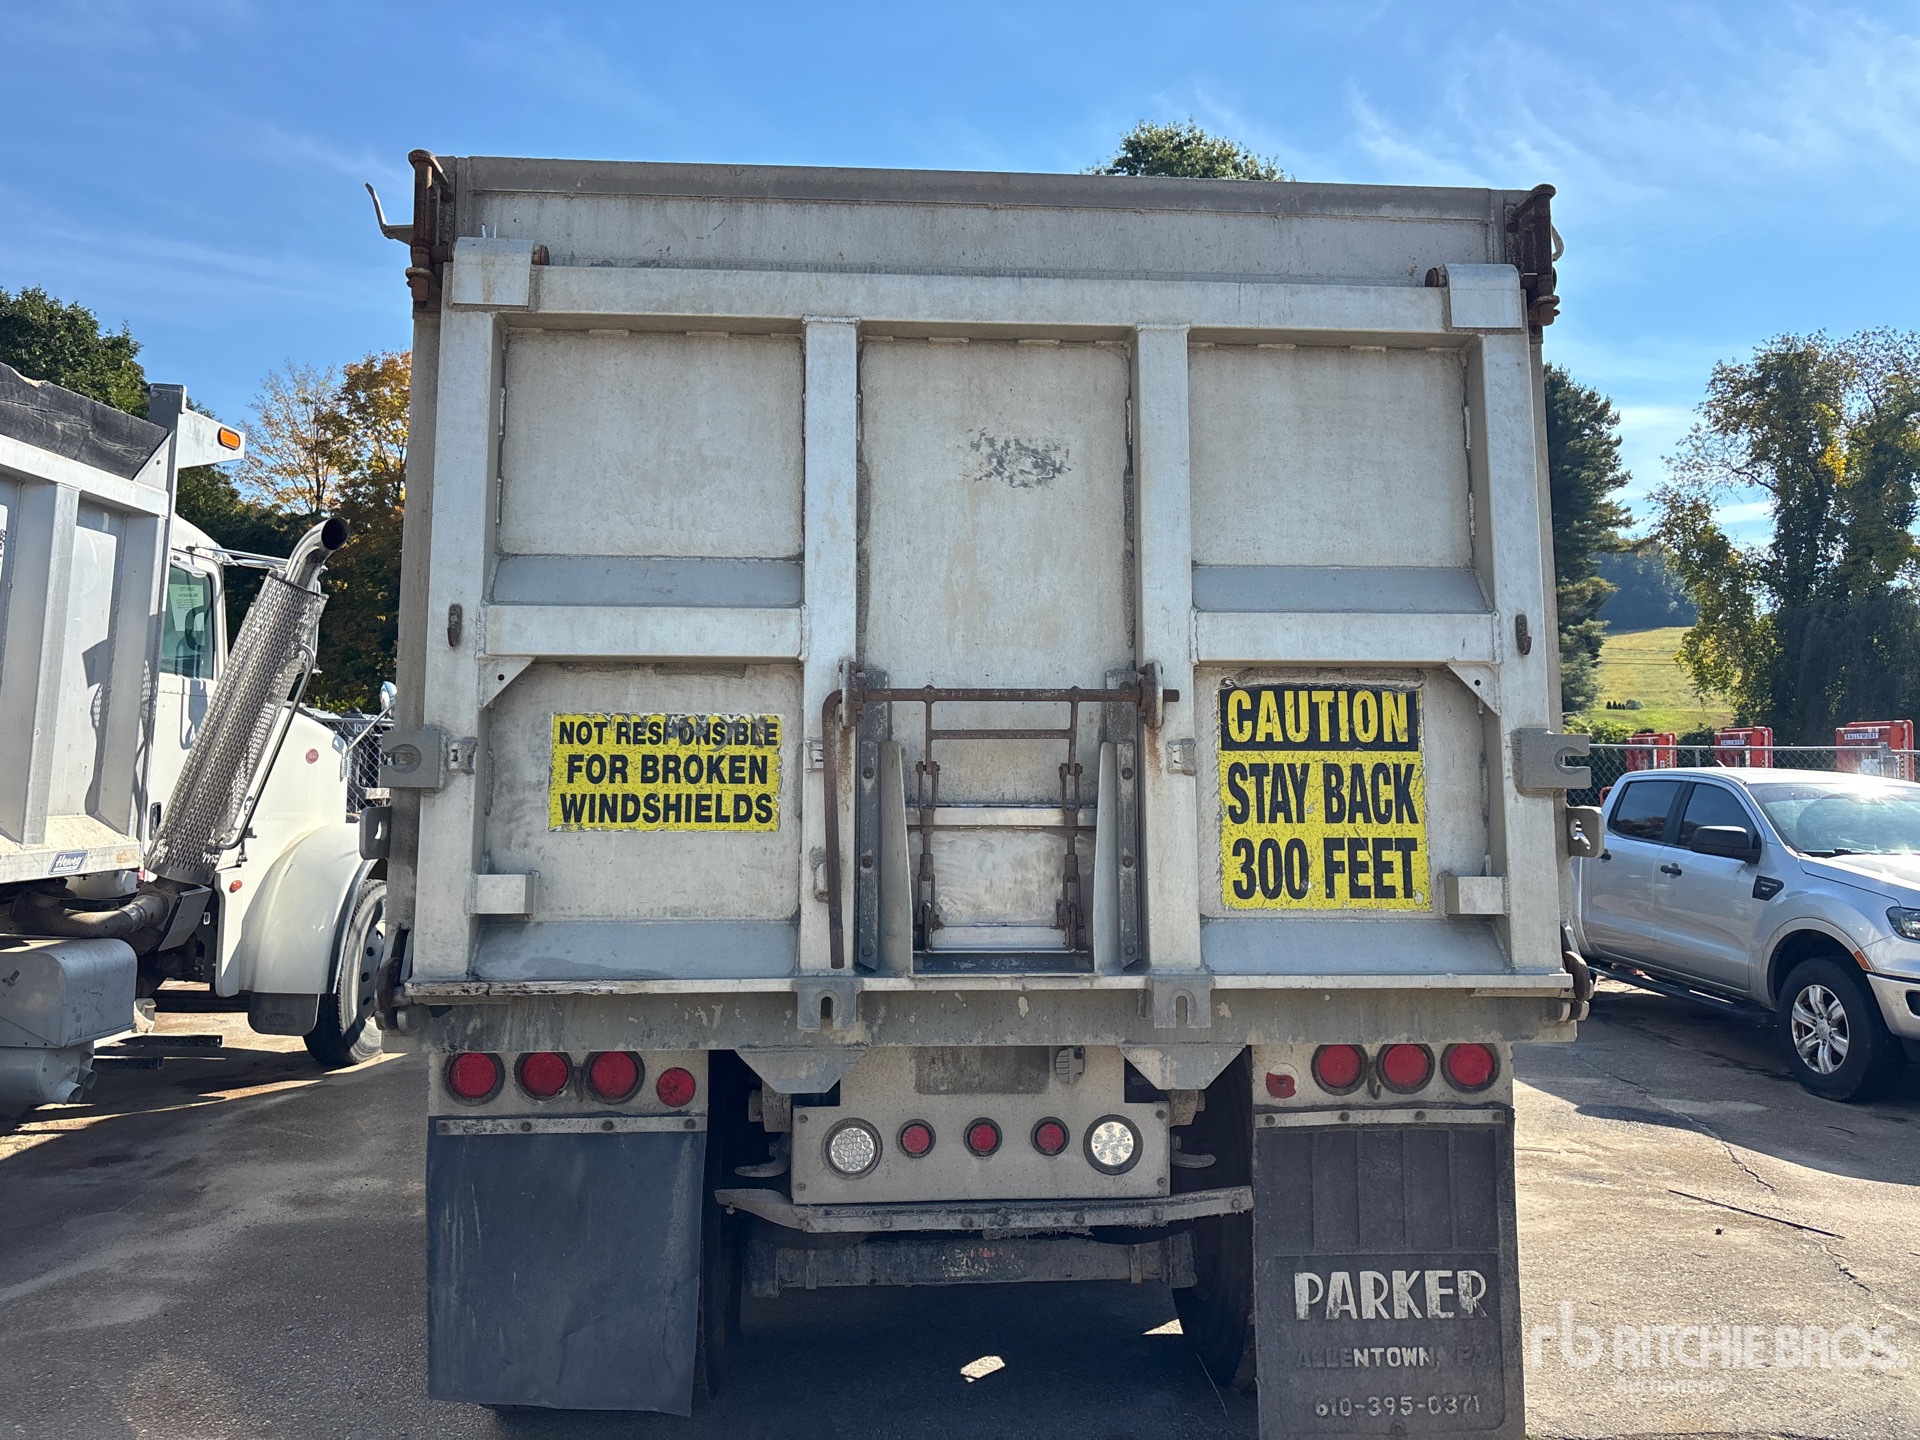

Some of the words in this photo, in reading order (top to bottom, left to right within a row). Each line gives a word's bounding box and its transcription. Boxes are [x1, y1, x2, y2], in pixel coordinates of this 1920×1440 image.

[559, 721, 607, 745] NOT
[1227, 689, 1409, 743] CAUTION
[566, 754, 629, 784] FOR
[640, 754, 768, 785] BROKEN
[559, 793, 773, 824] WINDSHIELDS
[1227, 762, 1311, 824] STAY
[1322, 762, 1419, 824] BACK
[1232, 837, 1310, 900] 300
[1323, 837, 1418, 899] FEET
[1294, 1269, 1488, 1321] PARKER
[1315, 1394, 1481, 1417] 610-395-0371
